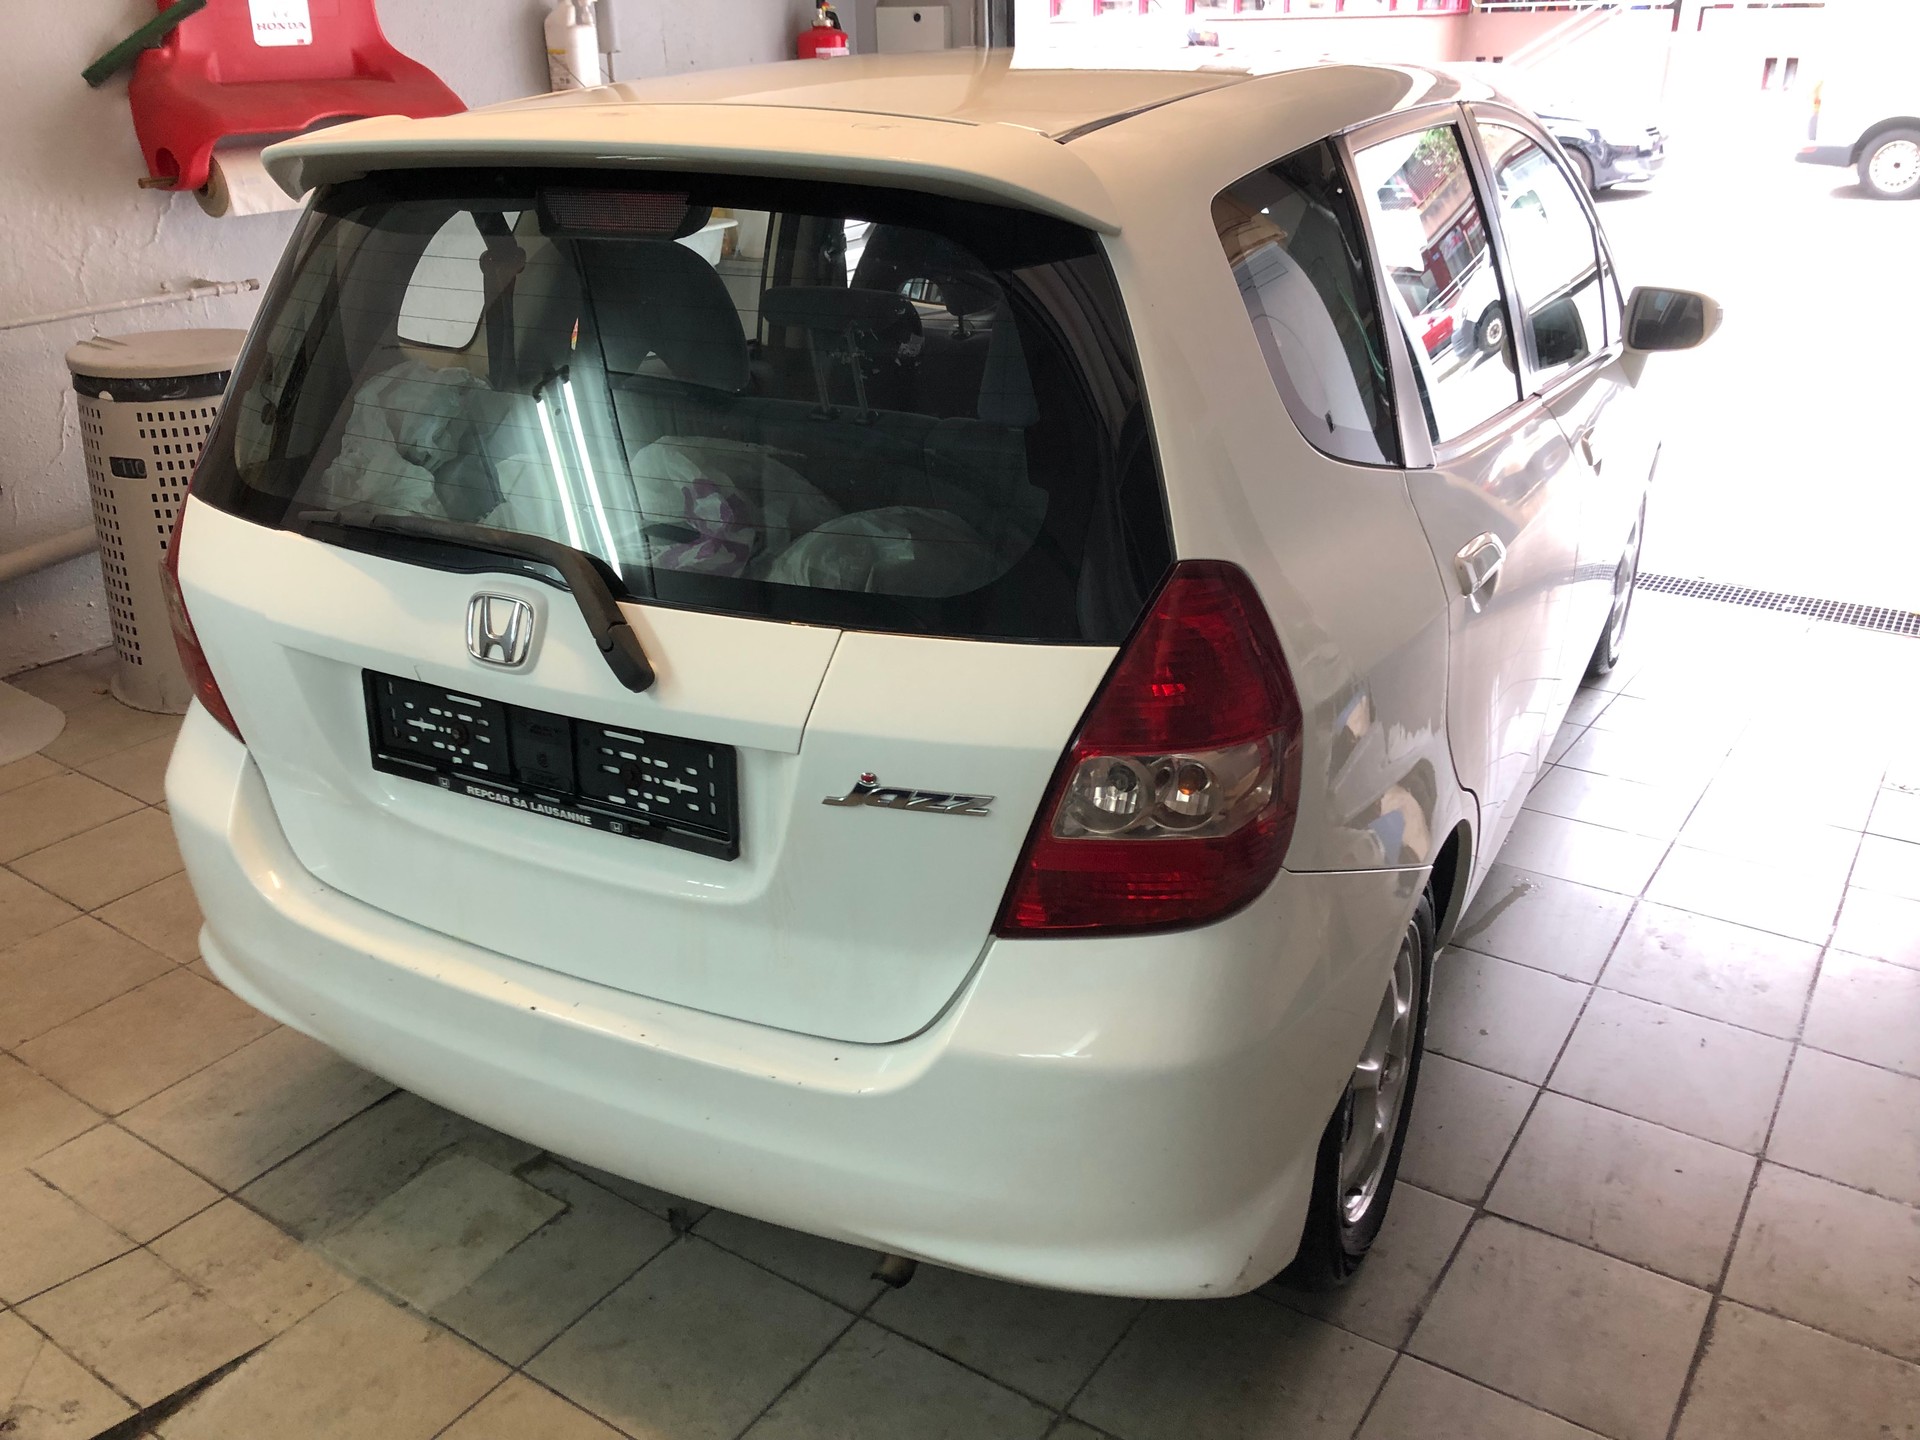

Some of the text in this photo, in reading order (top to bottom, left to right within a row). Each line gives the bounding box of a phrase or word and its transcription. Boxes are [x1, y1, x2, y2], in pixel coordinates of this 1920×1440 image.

[256, 22, 307, 31] HONDA
[466, 785, 592, 825] REPCAR SA LAUSANNE
